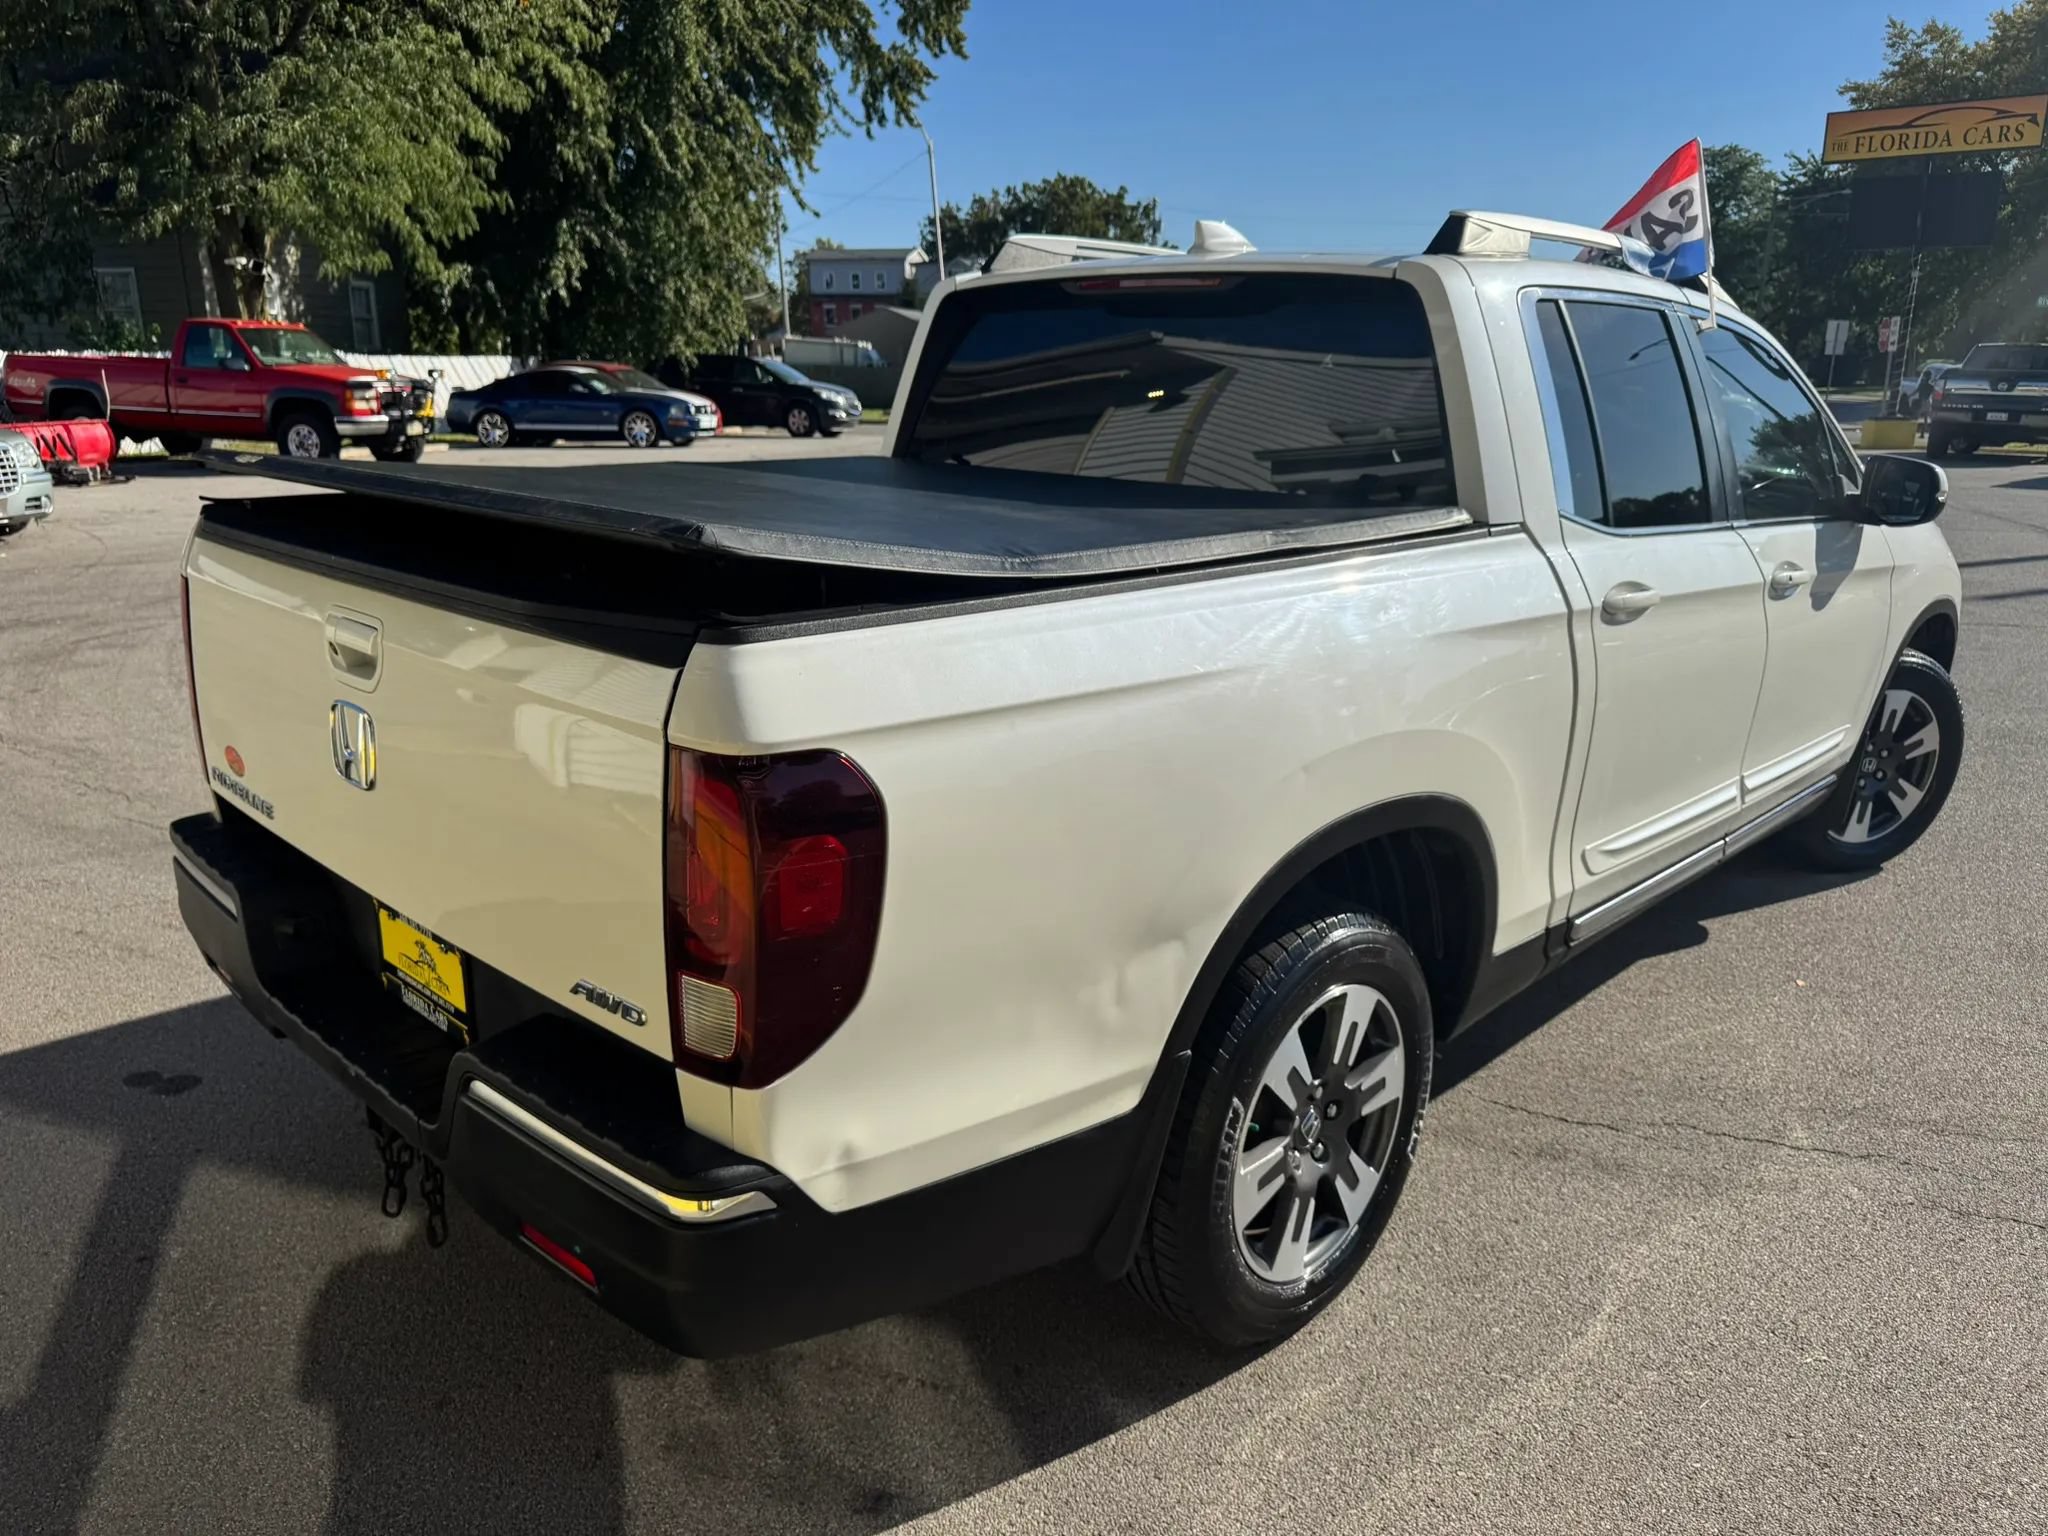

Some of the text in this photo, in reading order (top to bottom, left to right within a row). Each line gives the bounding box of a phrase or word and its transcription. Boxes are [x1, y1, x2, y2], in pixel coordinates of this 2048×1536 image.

[1831, 122, 2026, 154] THE FLORIDA CARS
[568, 979, 648, 1027] AWD
